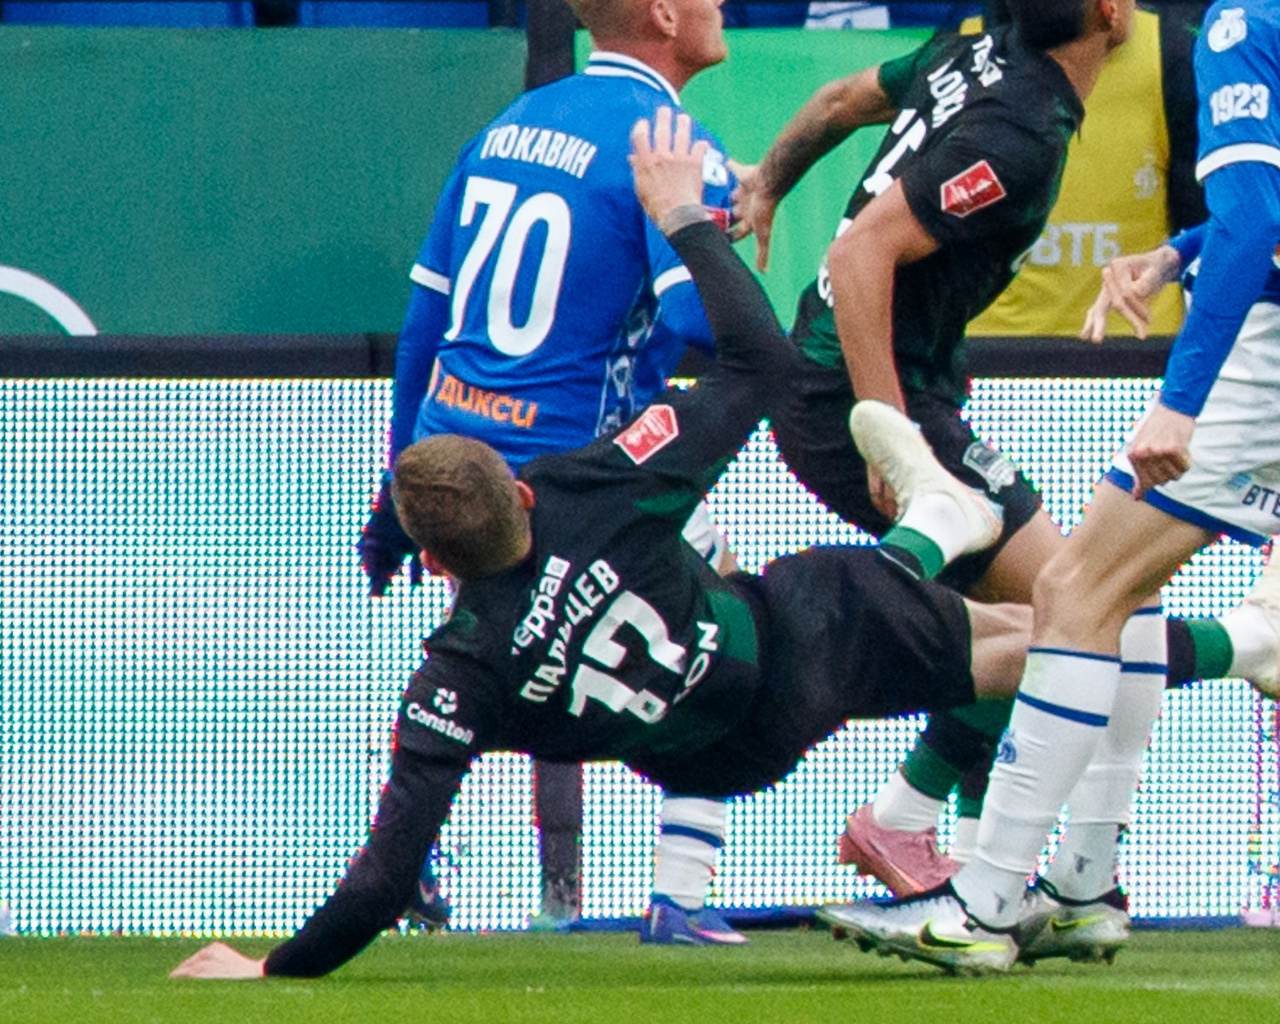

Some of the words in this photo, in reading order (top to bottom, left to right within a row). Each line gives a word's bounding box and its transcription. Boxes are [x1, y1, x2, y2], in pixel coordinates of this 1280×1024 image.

[1210, 82, 1270, 126] 1923
[444, 176, 571, 357] 70
[1030, 222, 1120, 267] ВТБ
[567, 590, 686, 724] 17
